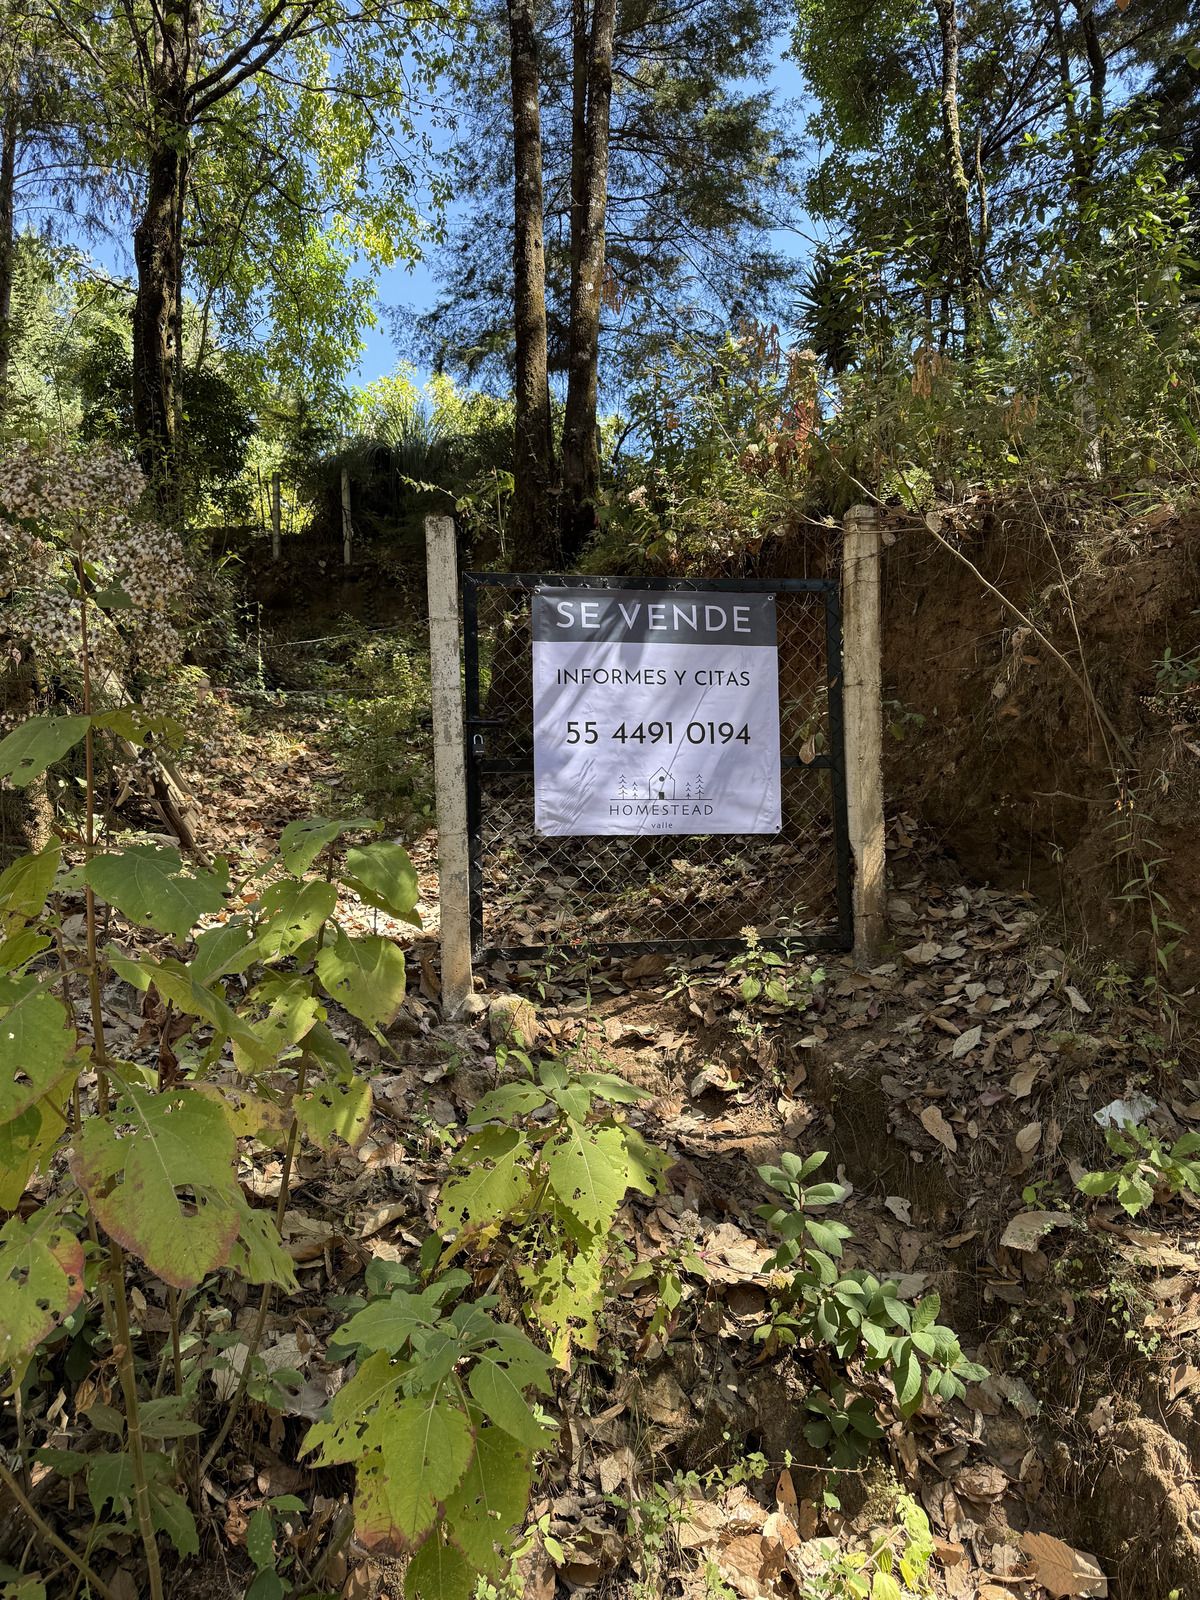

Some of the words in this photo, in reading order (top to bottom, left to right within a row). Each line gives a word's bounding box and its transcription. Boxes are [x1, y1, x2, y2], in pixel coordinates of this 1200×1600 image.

[556, 601, 601, 629] SE
[618, 603, 752, 633] VENDE
[557, 668, 667, 685] INFORMES
[674, 670, 686, 686] Y
[694, 670, 751, 687] CITAS
[566, 721, 599, 745] 55
[611, 721, 673, 745] 4491
[686, 721, 751, 745] 0194
[609, 804, 713, 816] HOMESTEAD
[651, 821, 673, 829] valle
